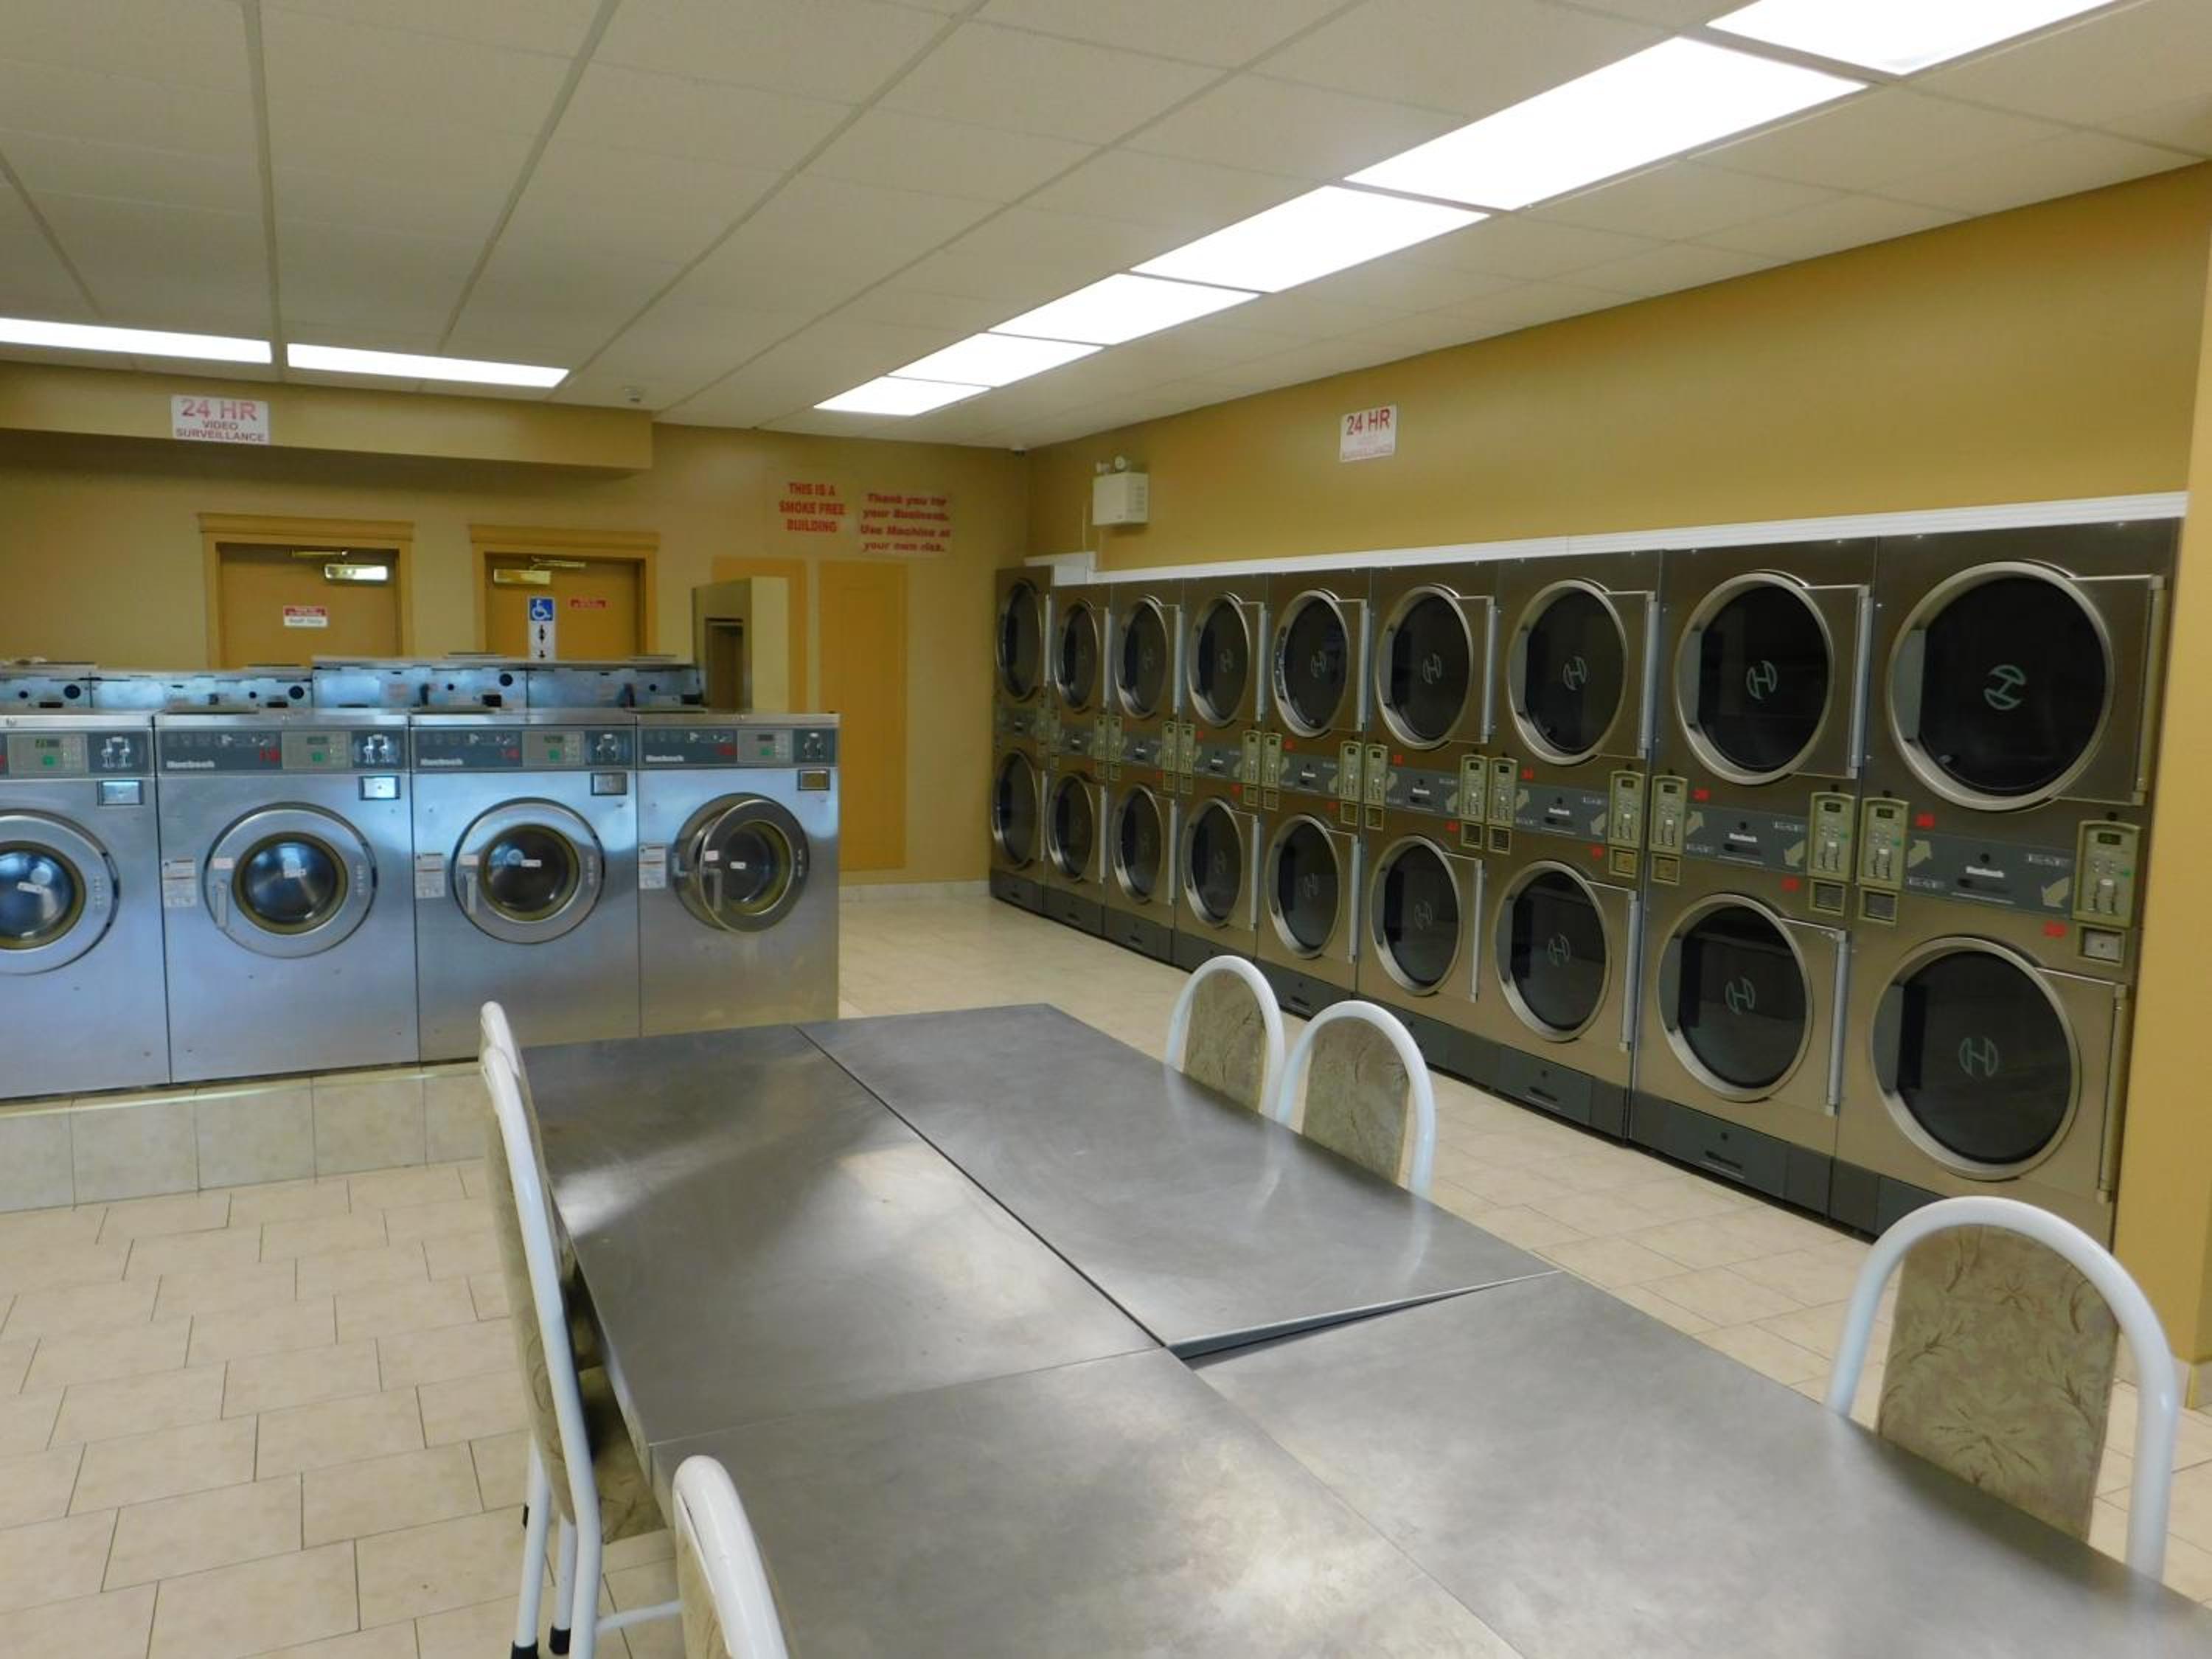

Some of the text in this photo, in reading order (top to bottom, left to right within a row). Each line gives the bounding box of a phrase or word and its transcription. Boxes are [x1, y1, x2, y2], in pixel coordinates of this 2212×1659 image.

[181, 398, 257, 421] 24 HR
[202, 420, 238, 430] VIDEO
[1346, 408, 1390, 436] 24 HR
[176, 428, 265, 441] SURVEILLANCE
[788, 482, 836, 496] THIS IS A
[779, 500, 846, 515] SMOKE FREE
[787, 519, 837, 533] BUILDING
